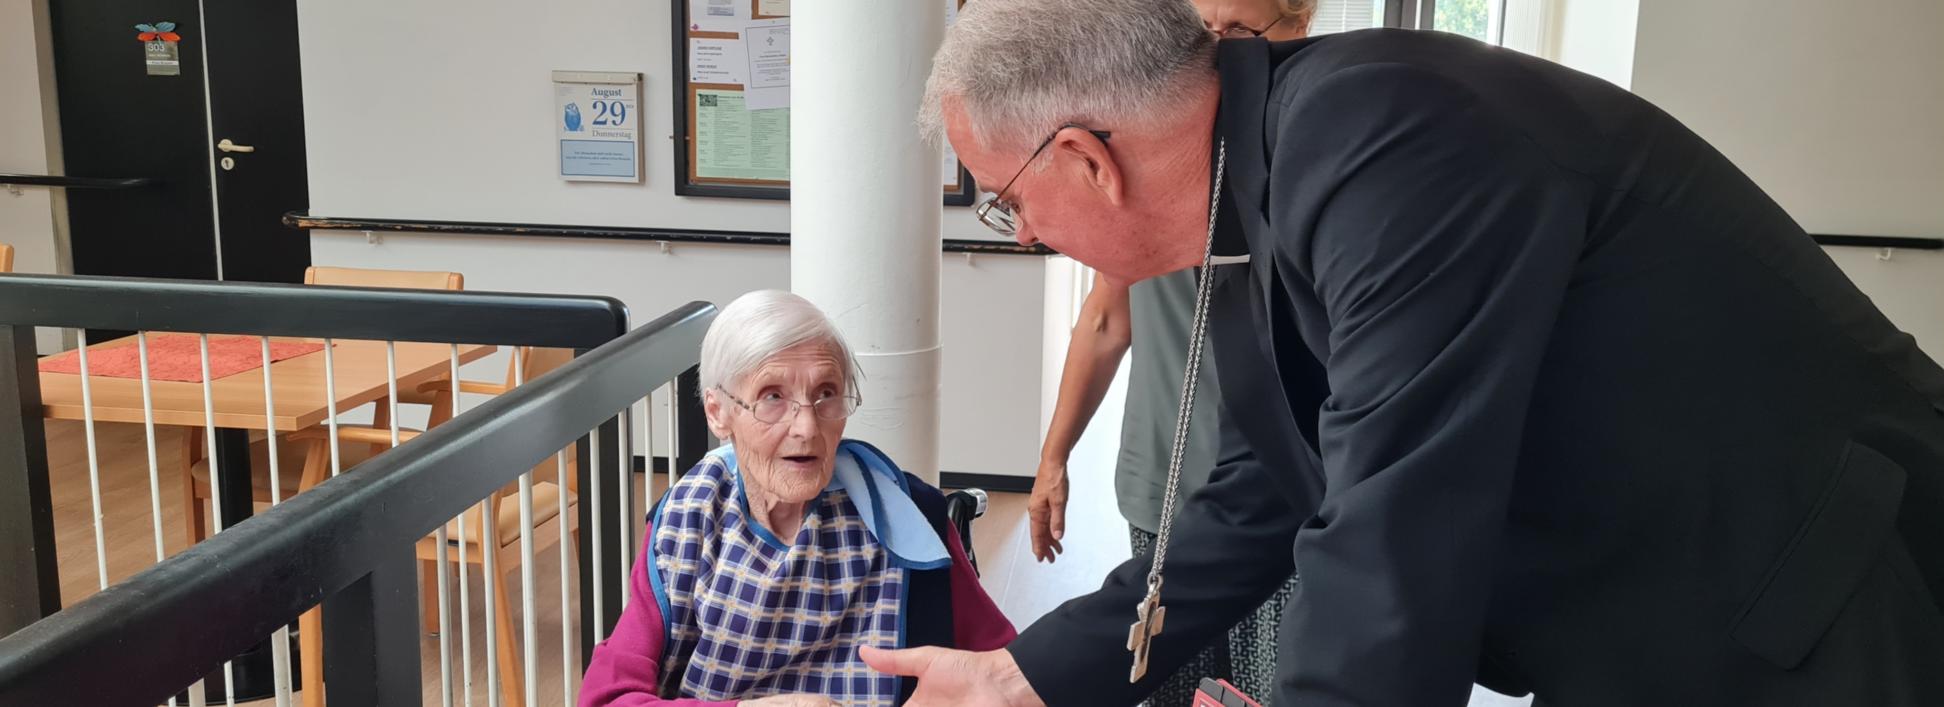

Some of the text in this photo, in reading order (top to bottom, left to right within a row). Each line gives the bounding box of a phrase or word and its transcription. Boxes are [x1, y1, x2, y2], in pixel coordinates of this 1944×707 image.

[591, 87, 622, 98] August
[592, 100, 626, 126] 29
[592, 130, 632, 139] Donnerstag
